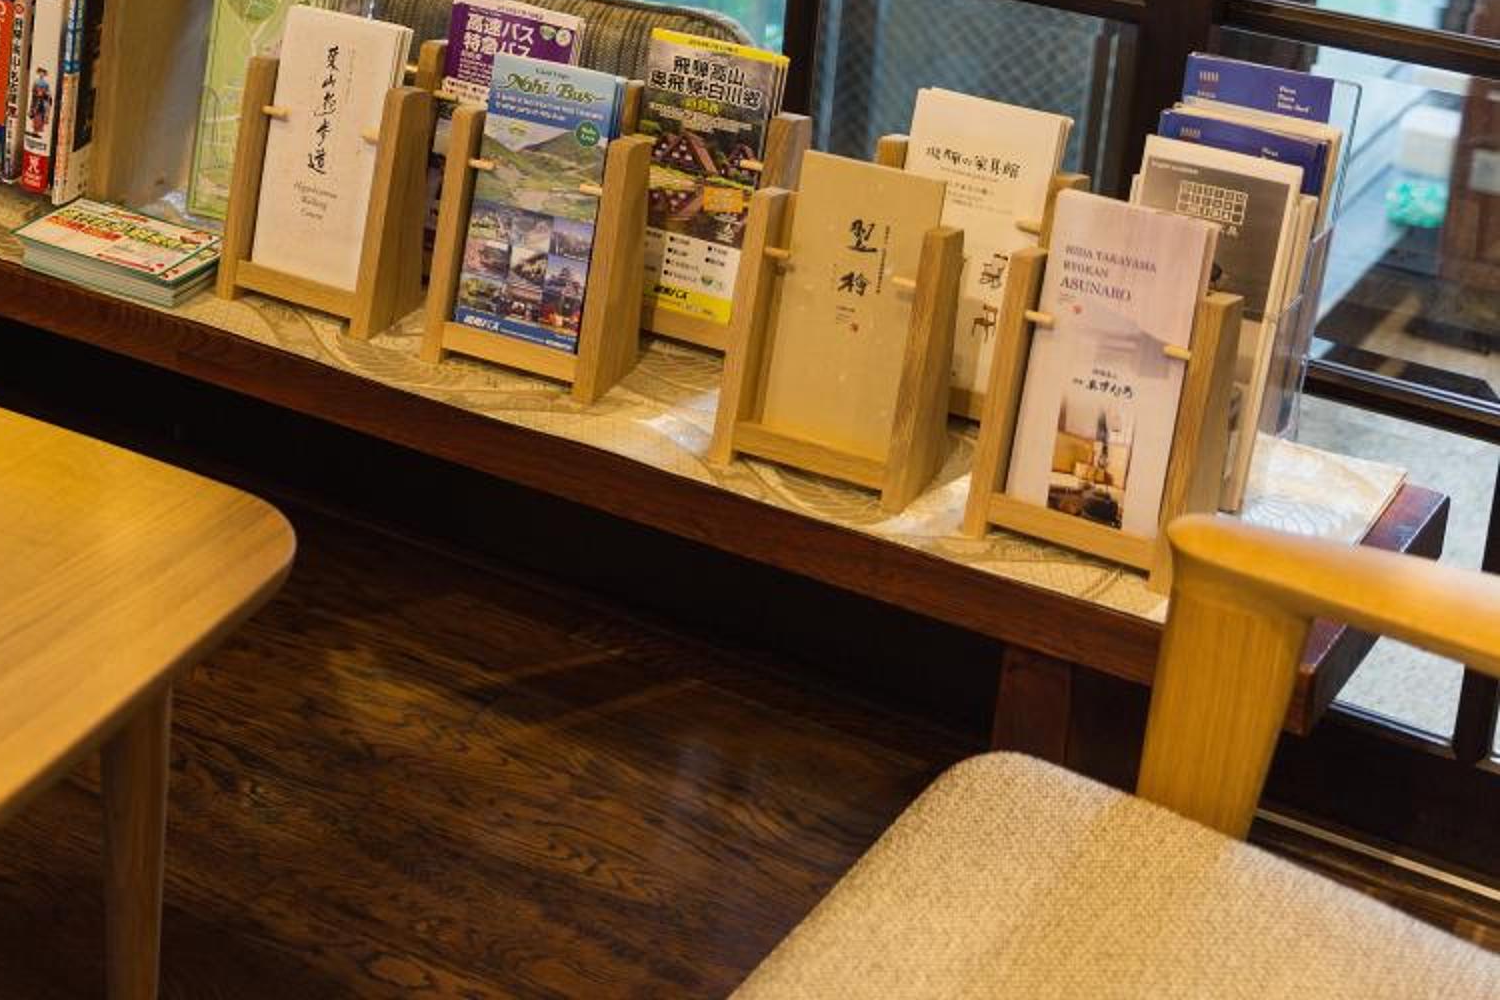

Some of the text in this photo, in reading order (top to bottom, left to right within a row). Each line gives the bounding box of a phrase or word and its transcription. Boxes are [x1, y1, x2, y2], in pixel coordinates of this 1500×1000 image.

[466, 12, 535, 46] 高速バス
[673, 54, 746, 87] 飛騨高山
[499, 72, 550, 96] Nohi
[554, 82, 606, 106] Bus
[1063, 261, 1109, 278] RYOKAN
[1065, 245, 1157, 273] HIDA TAKAYAMA
[1059, 276, 1132, 301] ASUNARO
